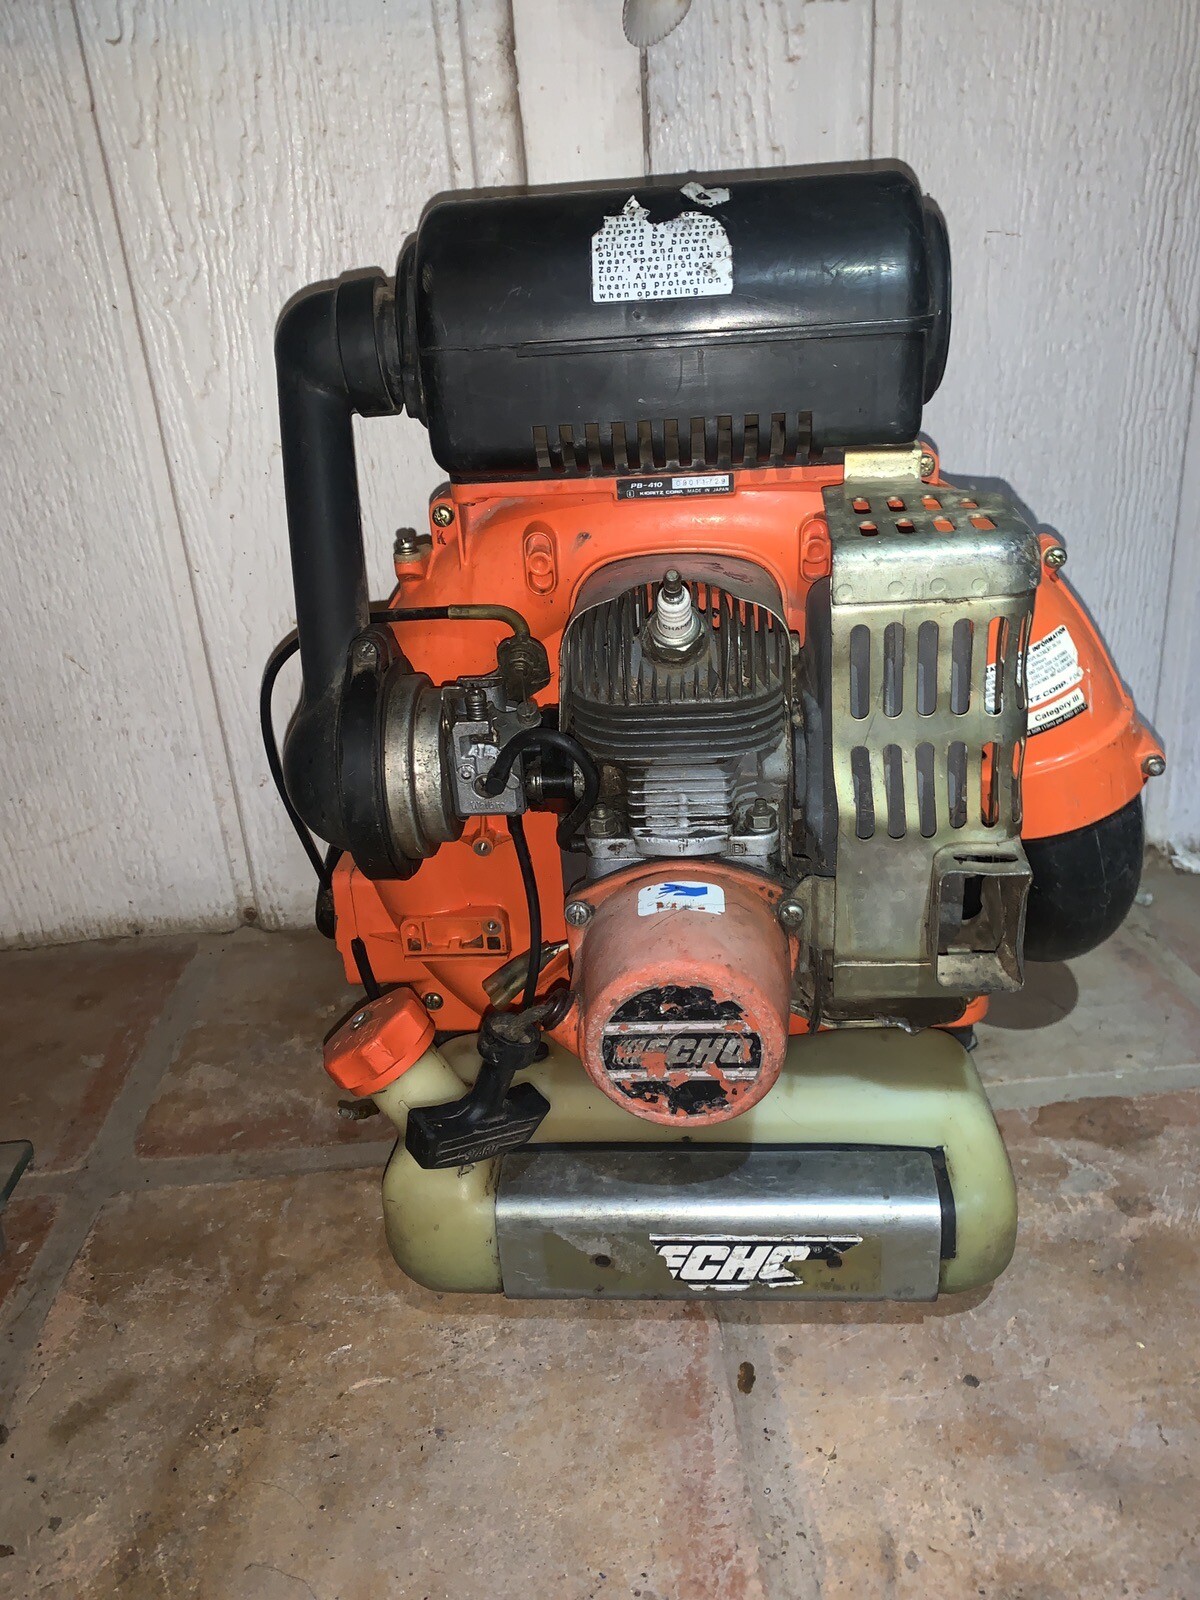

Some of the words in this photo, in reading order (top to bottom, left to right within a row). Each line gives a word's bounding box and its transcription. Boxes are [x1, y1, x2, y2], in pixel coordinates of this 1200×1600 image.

[603, 221, 646, 229] anual.
[672, 229, 726, 238] severely
[598, 240, 643, 250] injured
[598, 249, 644, 258] objects
[652, 246, 674, 254] and
[681, 244, 710, 252] must
[633, 252, 691, 264] specified
[698, 250, 727, 259] ANSI
[598, 265, 631, 274] Z87.1
[638, 264, 658, 272] eye
[666, 261, 712, 270] protec-
[598, 274, 628, 282] tion.
[636, 271, 678, 280] Always
[598, 282, 646, 290] hearing
[637, 286, 704, 298] operating.
[1034, 700, 1071, 722] Category
